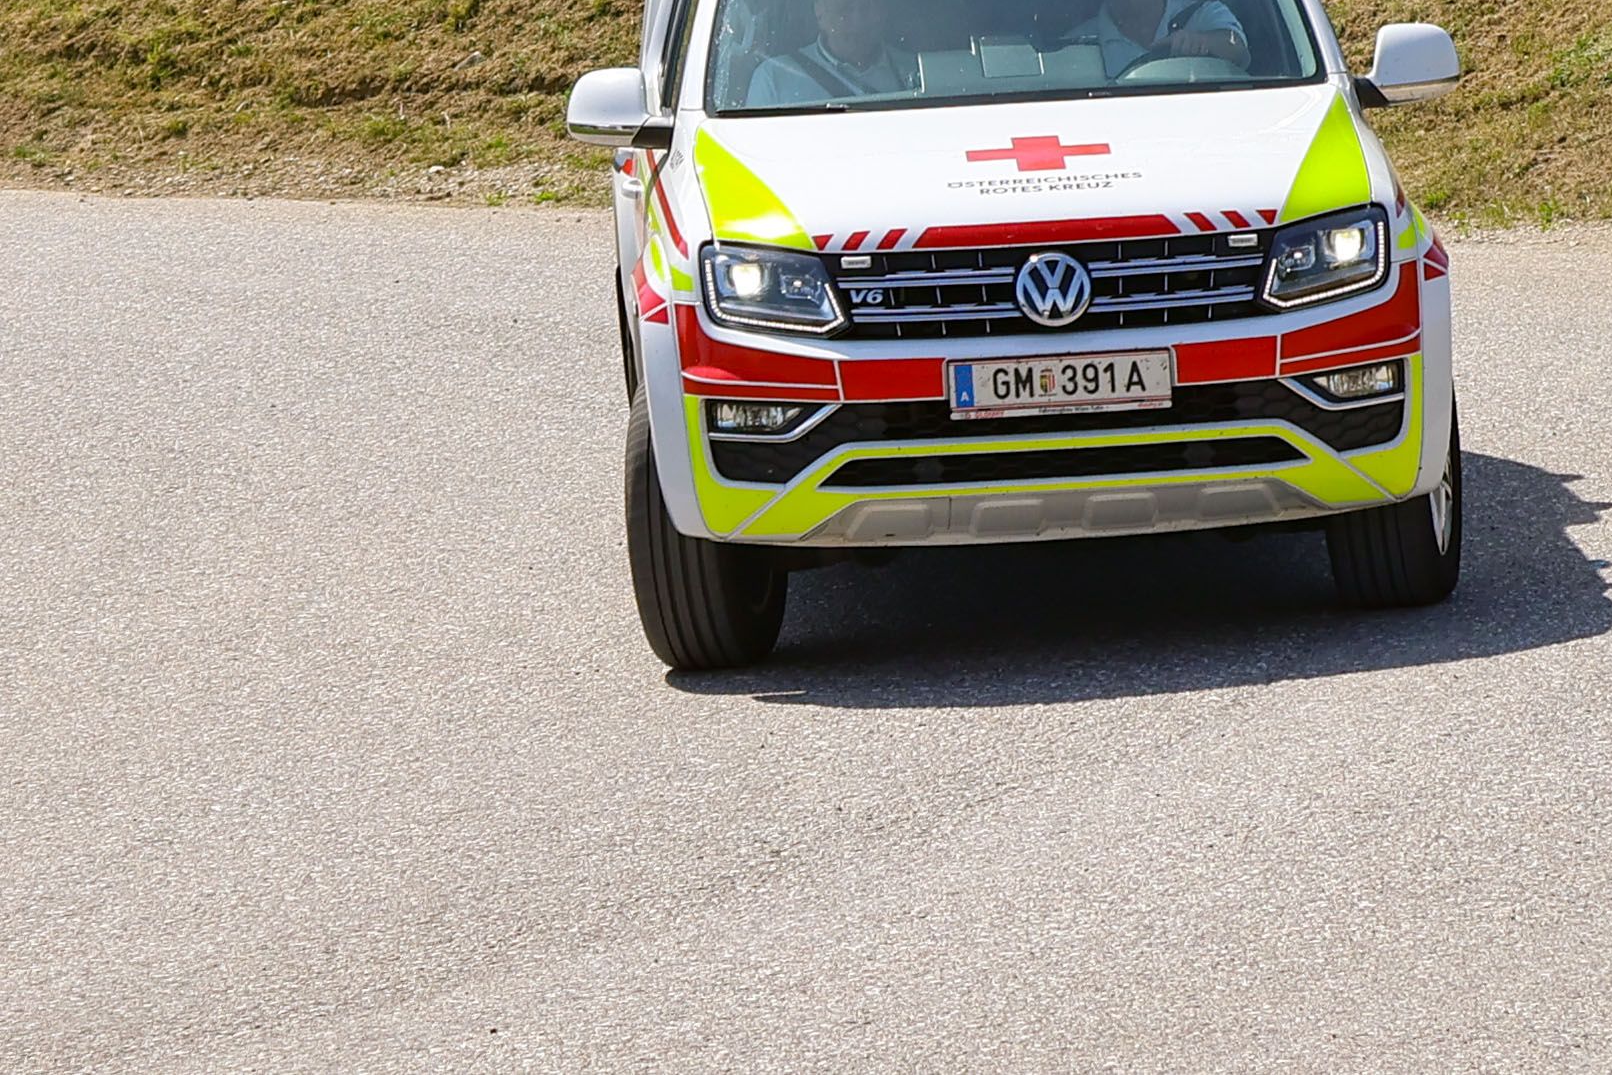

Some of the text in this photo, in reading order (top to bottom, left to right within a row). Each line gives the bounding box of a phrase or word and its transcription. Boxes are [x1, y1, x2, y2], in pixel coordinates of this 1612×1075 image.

[947, 171, 1143, 189] ÖSTERREICHISCHES
[979, 180, 1114, 196] ROTES KREUZ
[850, 288, 883, 305] V6
[960, 360, 1146, 402] A GM 391A
